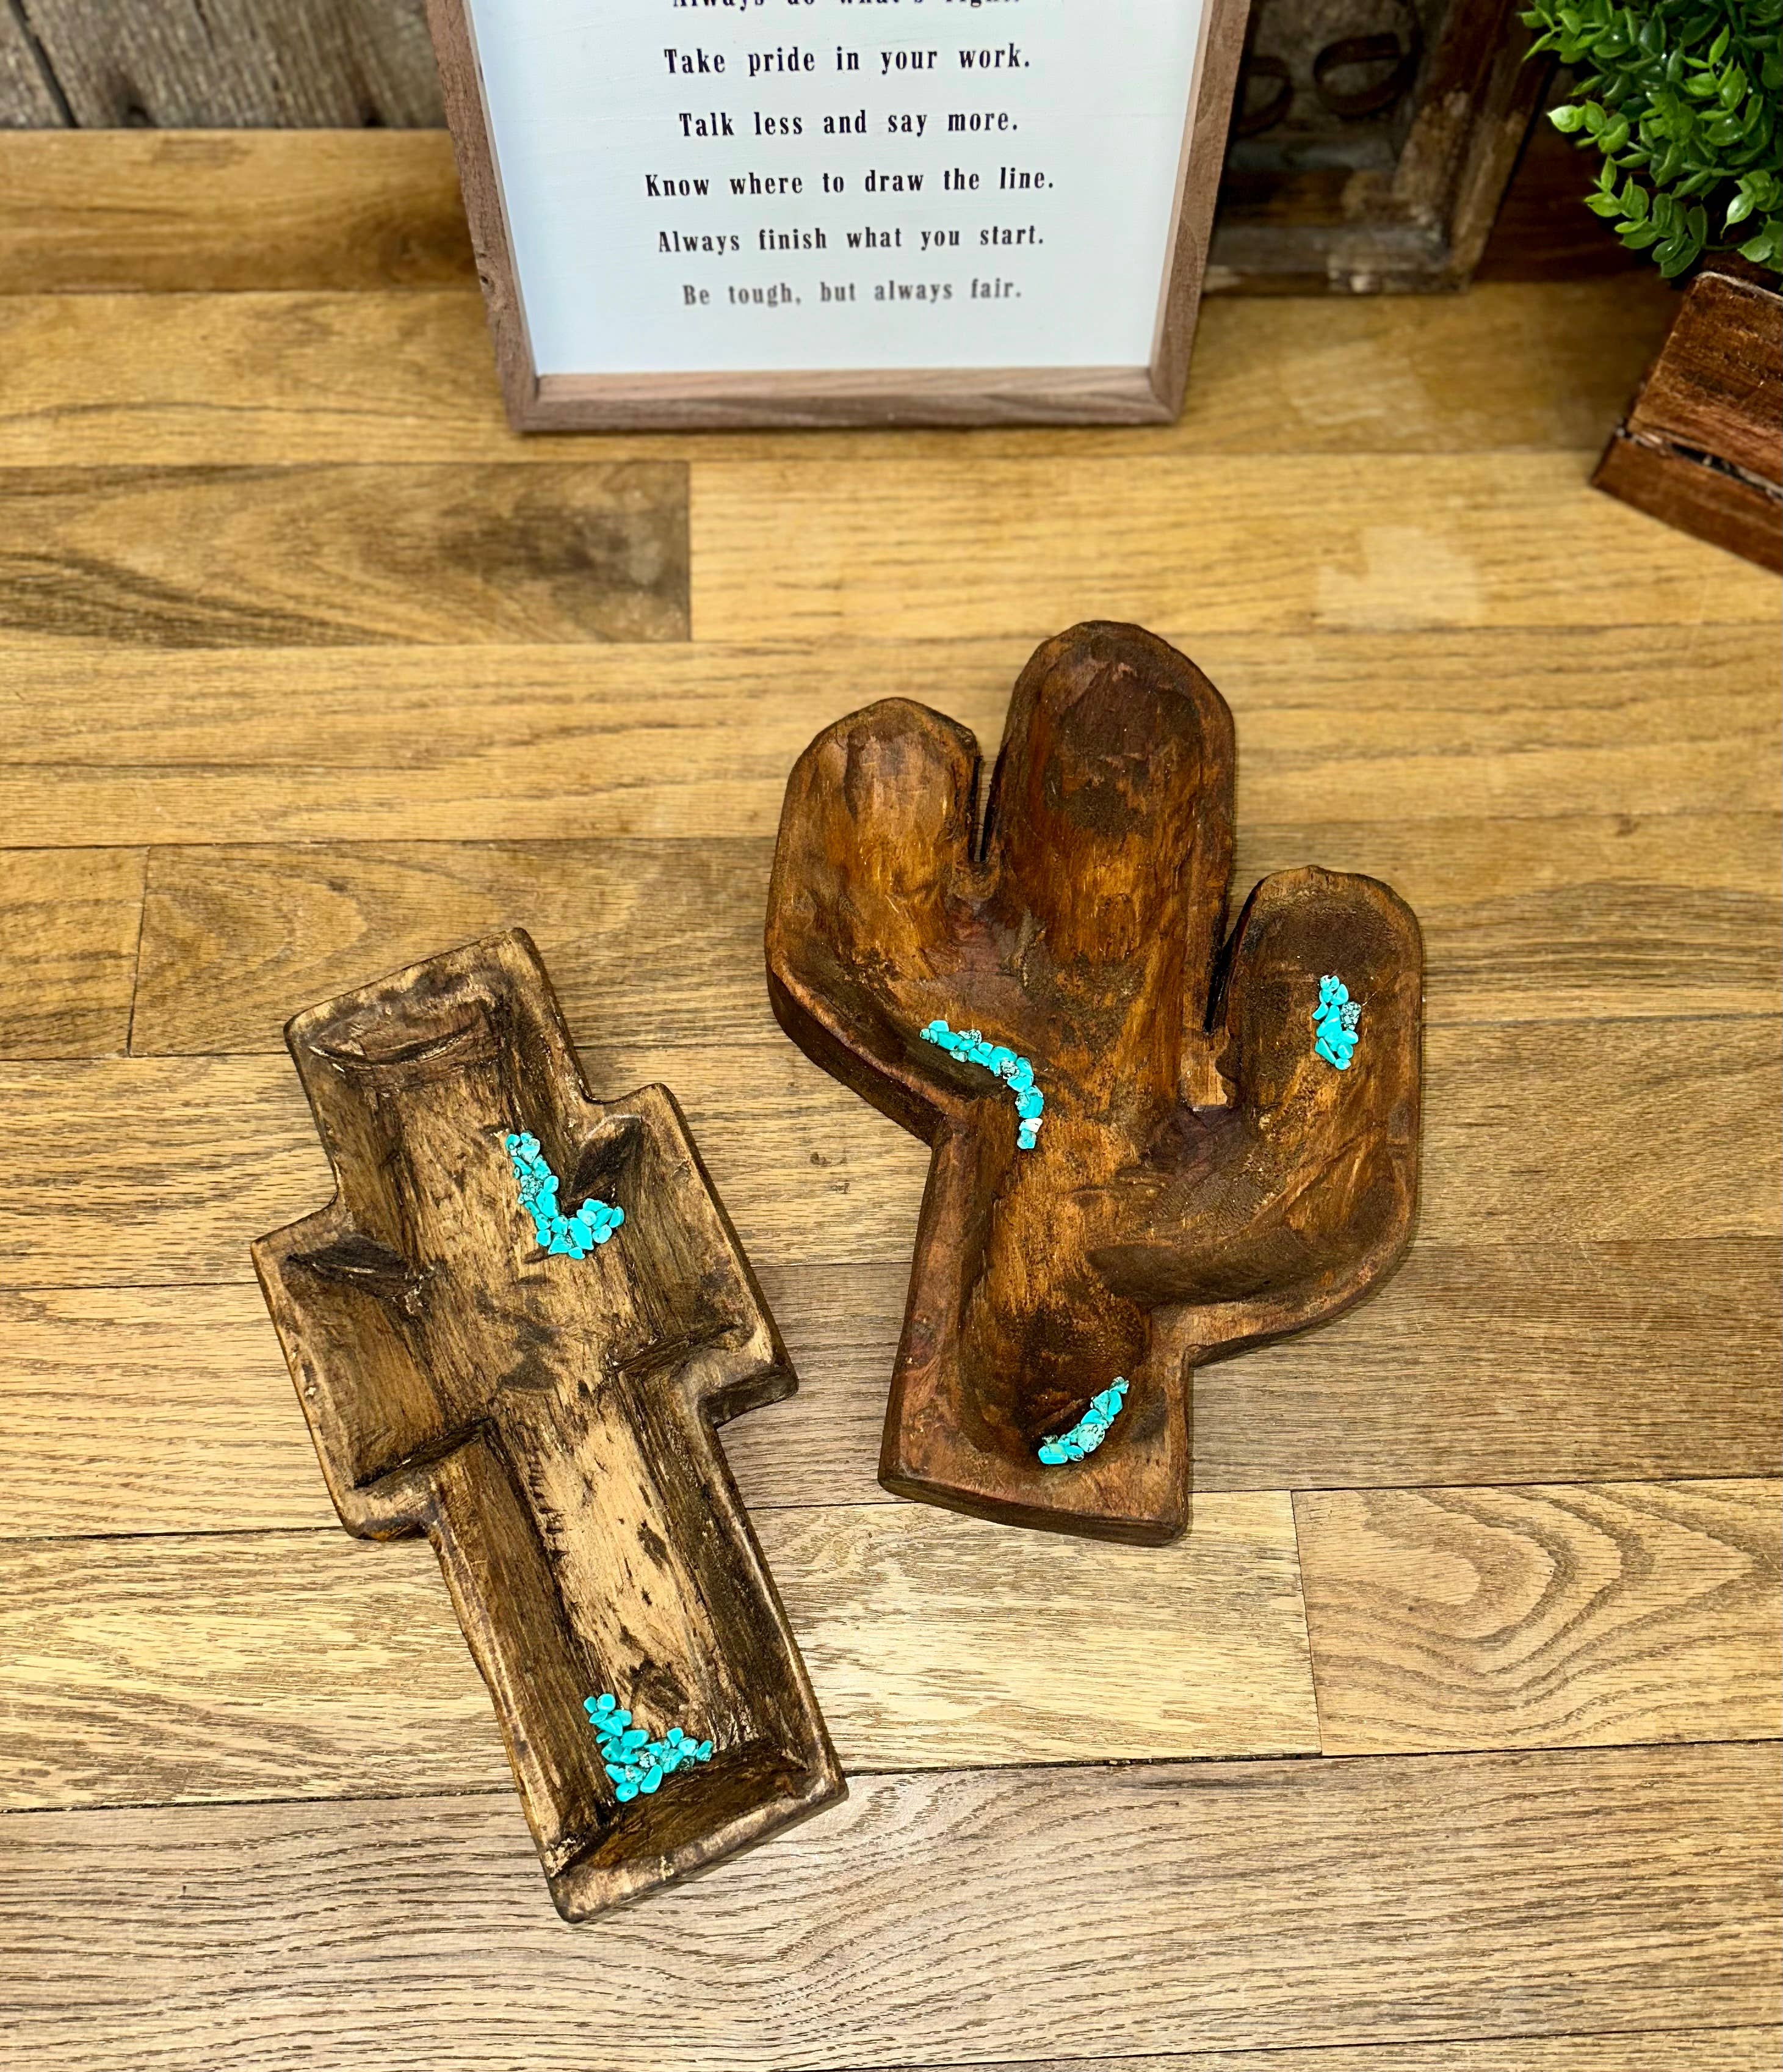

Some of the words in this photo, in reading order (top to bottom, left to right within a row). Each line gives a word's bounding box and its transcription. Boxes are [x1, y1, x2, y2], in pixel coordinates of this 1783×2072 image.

[664, 48, 726, 73] Take
[748, 46, 815, 77] pride
[836, 45, 860, 70] in
[880, 50, 938, 75] your
[958, 42, 1030, 68] work.
[678, 112, 735, 137] Talk
[753, 111, 803, 135] less
[823, 109, 867, 134] and
[888, 114, 928, 137] say
[947, 112, 1018, 131] more.
[645, 174, 709, 197] Know
[729, 172, 803, 195] where
[822, 172, 844, 193] to
[865, 169, 924, 192] draw
[943, 167, 980, 190] the
[999, 166, 1054, 189] line.
[659, 230, 740, 255] Always
[759, 227, 827, 250] finish
[846, 226, 902, 248] what
[920, 230, 960, 251] you
[980, 225, 1044, 245] start.
[682, 284, 710, 305] Be
[728, 283, 801, 306] tough,
[820, 281, 855, 302] but
[874, 280, 952, 303] always
[971, 278, 1021, 299] fair.
